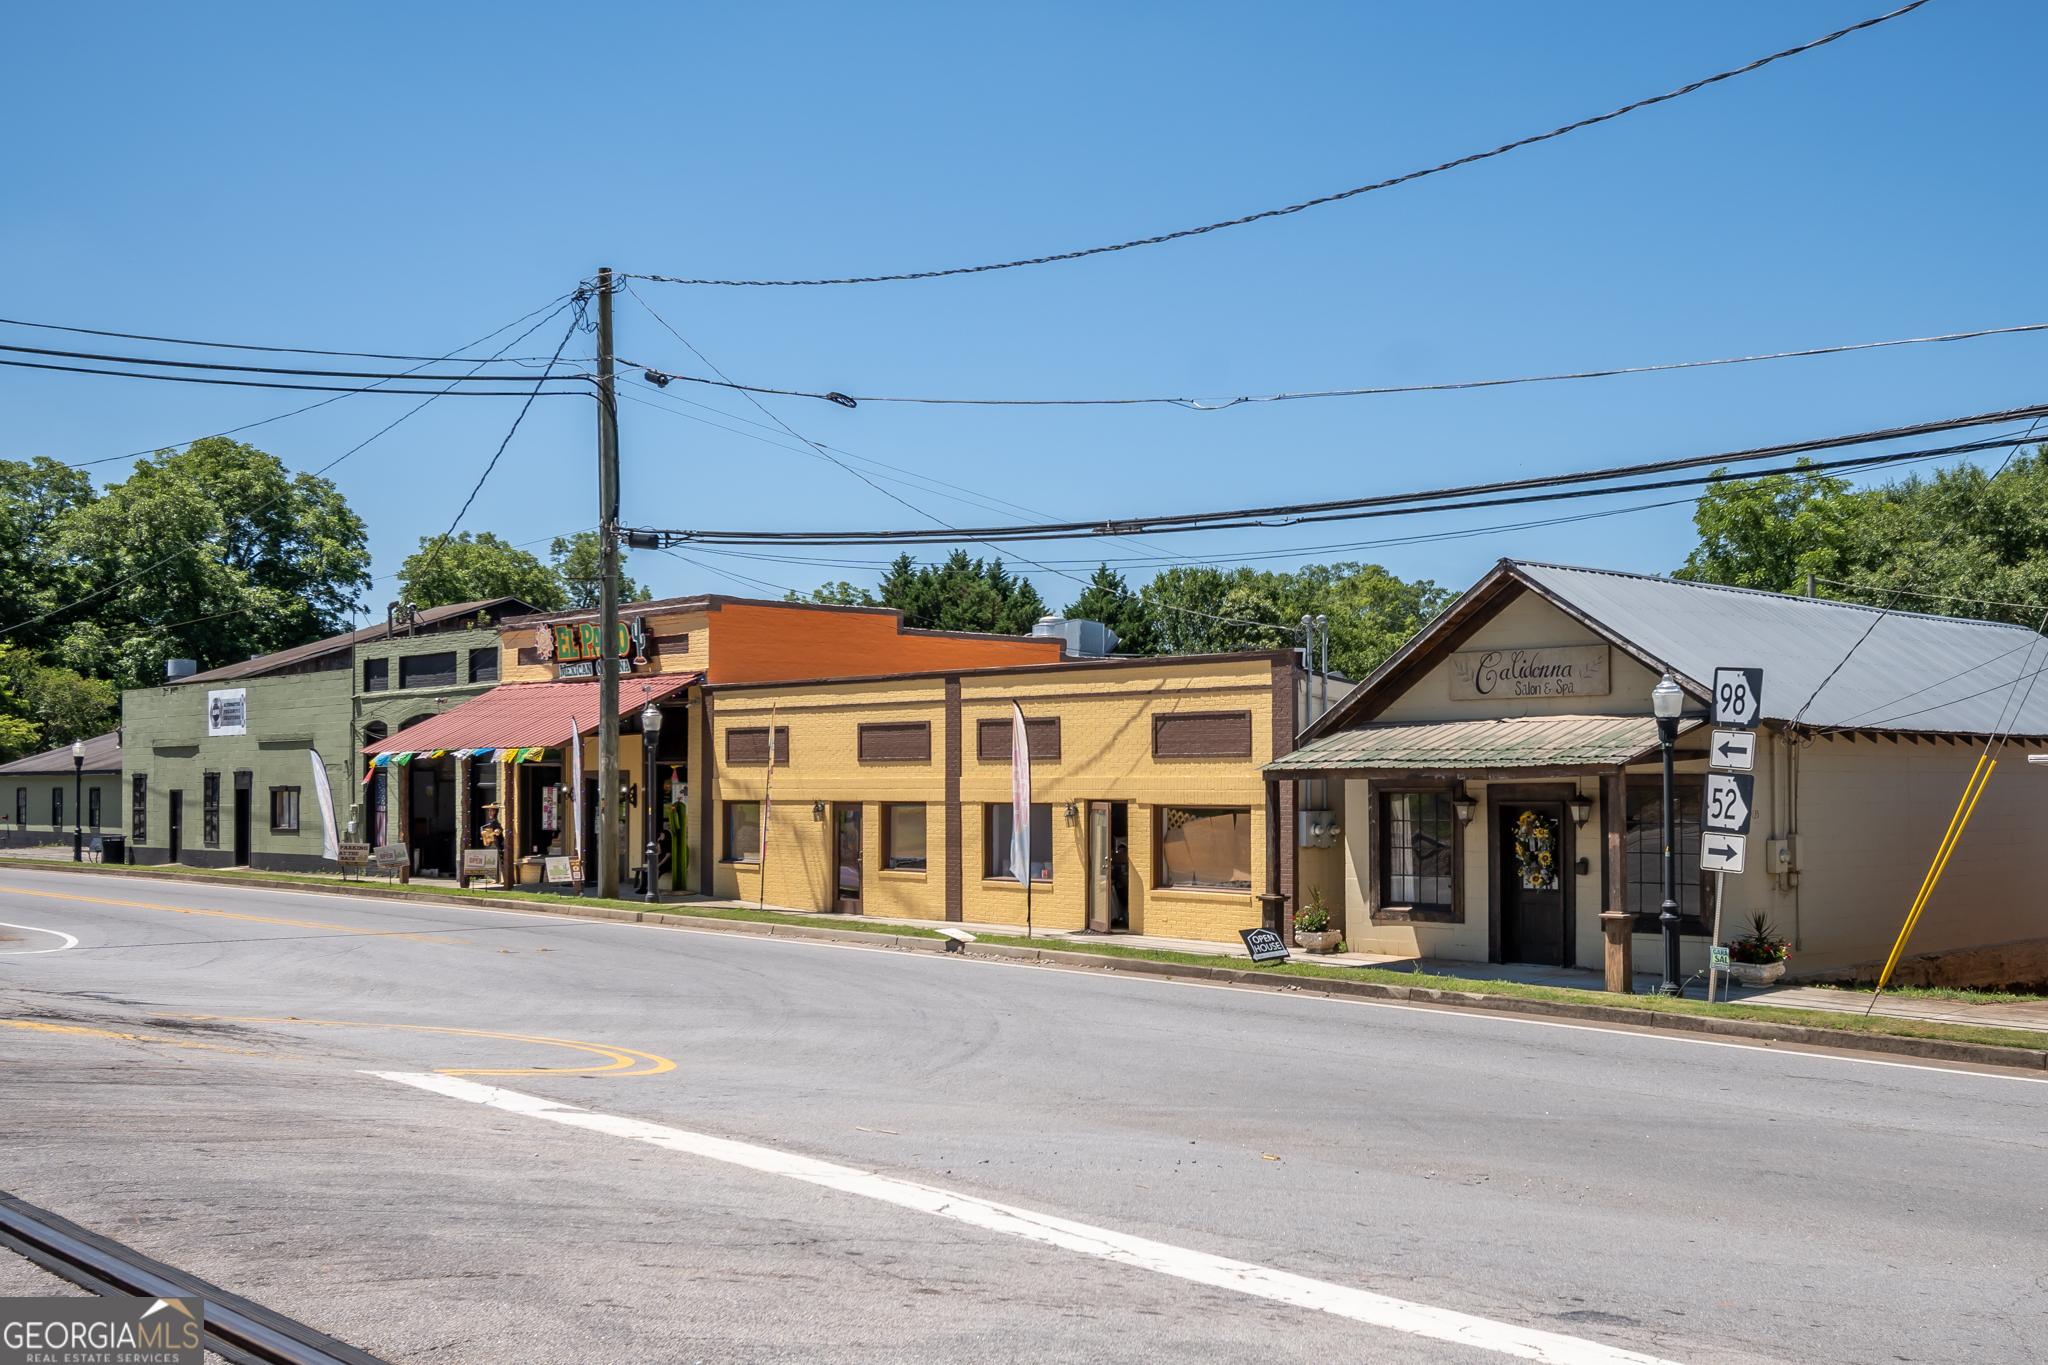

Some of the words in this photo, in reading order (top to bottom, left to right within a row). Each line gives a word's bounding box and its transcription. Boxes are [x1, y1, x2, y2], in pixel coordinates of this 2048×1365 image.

[554, 625, 580, 660] EL
[580, 621, 631, 658] PAO
[560, 662, 593, 677] MEXICAN
[1475, 650, 1573, 695] Calidonna
[1514, 681, 1542, 696] Salon
[1544, 682, 1551, 695] &
[1556, 679, 1575, 697] Spa
[1720, 683, 1746, 715] 98
[1711, 788, 1737, 820] 52
[1252, 934, 1275, 944] OPEN
[1253, 941, 1283, 953] HOUSE
